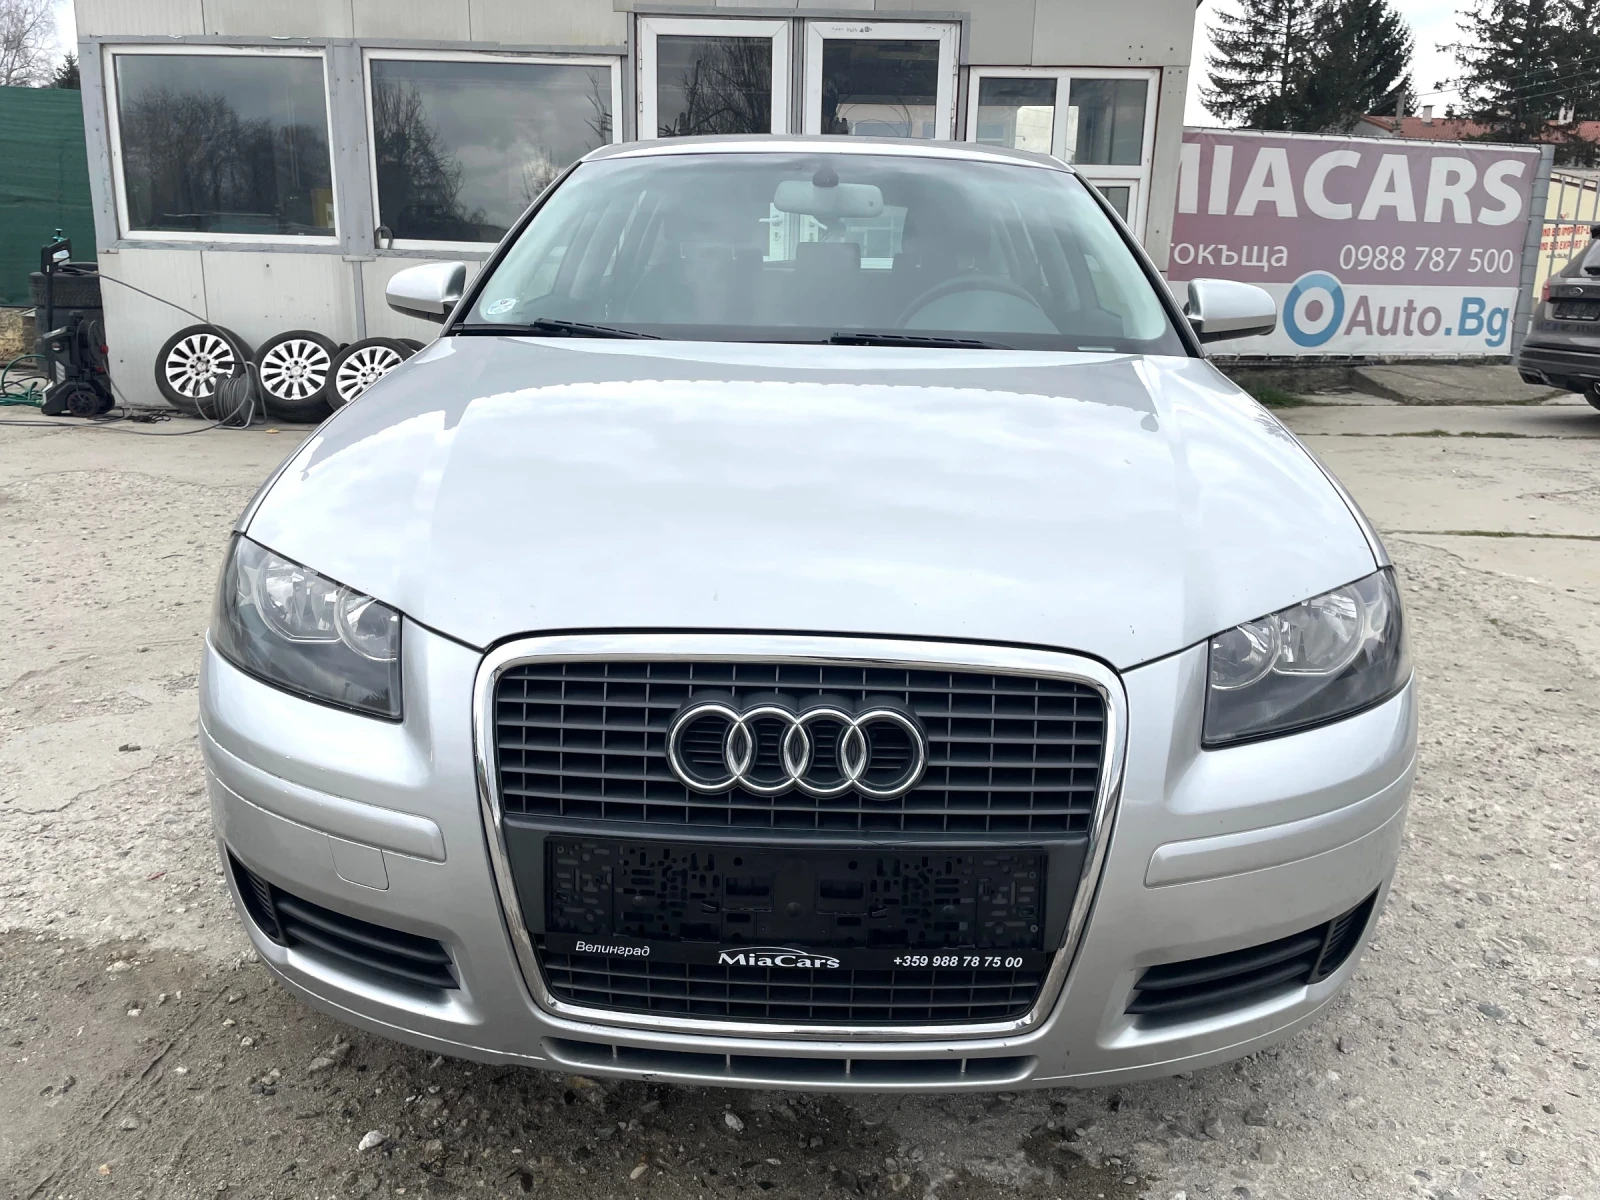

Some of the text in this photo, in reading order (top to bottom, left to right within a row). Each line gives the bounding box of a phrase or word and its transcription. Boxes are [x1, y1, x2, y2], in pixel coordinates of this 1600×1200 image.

[1170, 243, 1288, 272] окъща
[1339, 244, 1513, 274] 0988 787 500
[575, 940, 650, 957] Велинград
[718, 952, 840, 968] MiaCars
[893, 955, 1023, 967] +359 988 78 75 00
